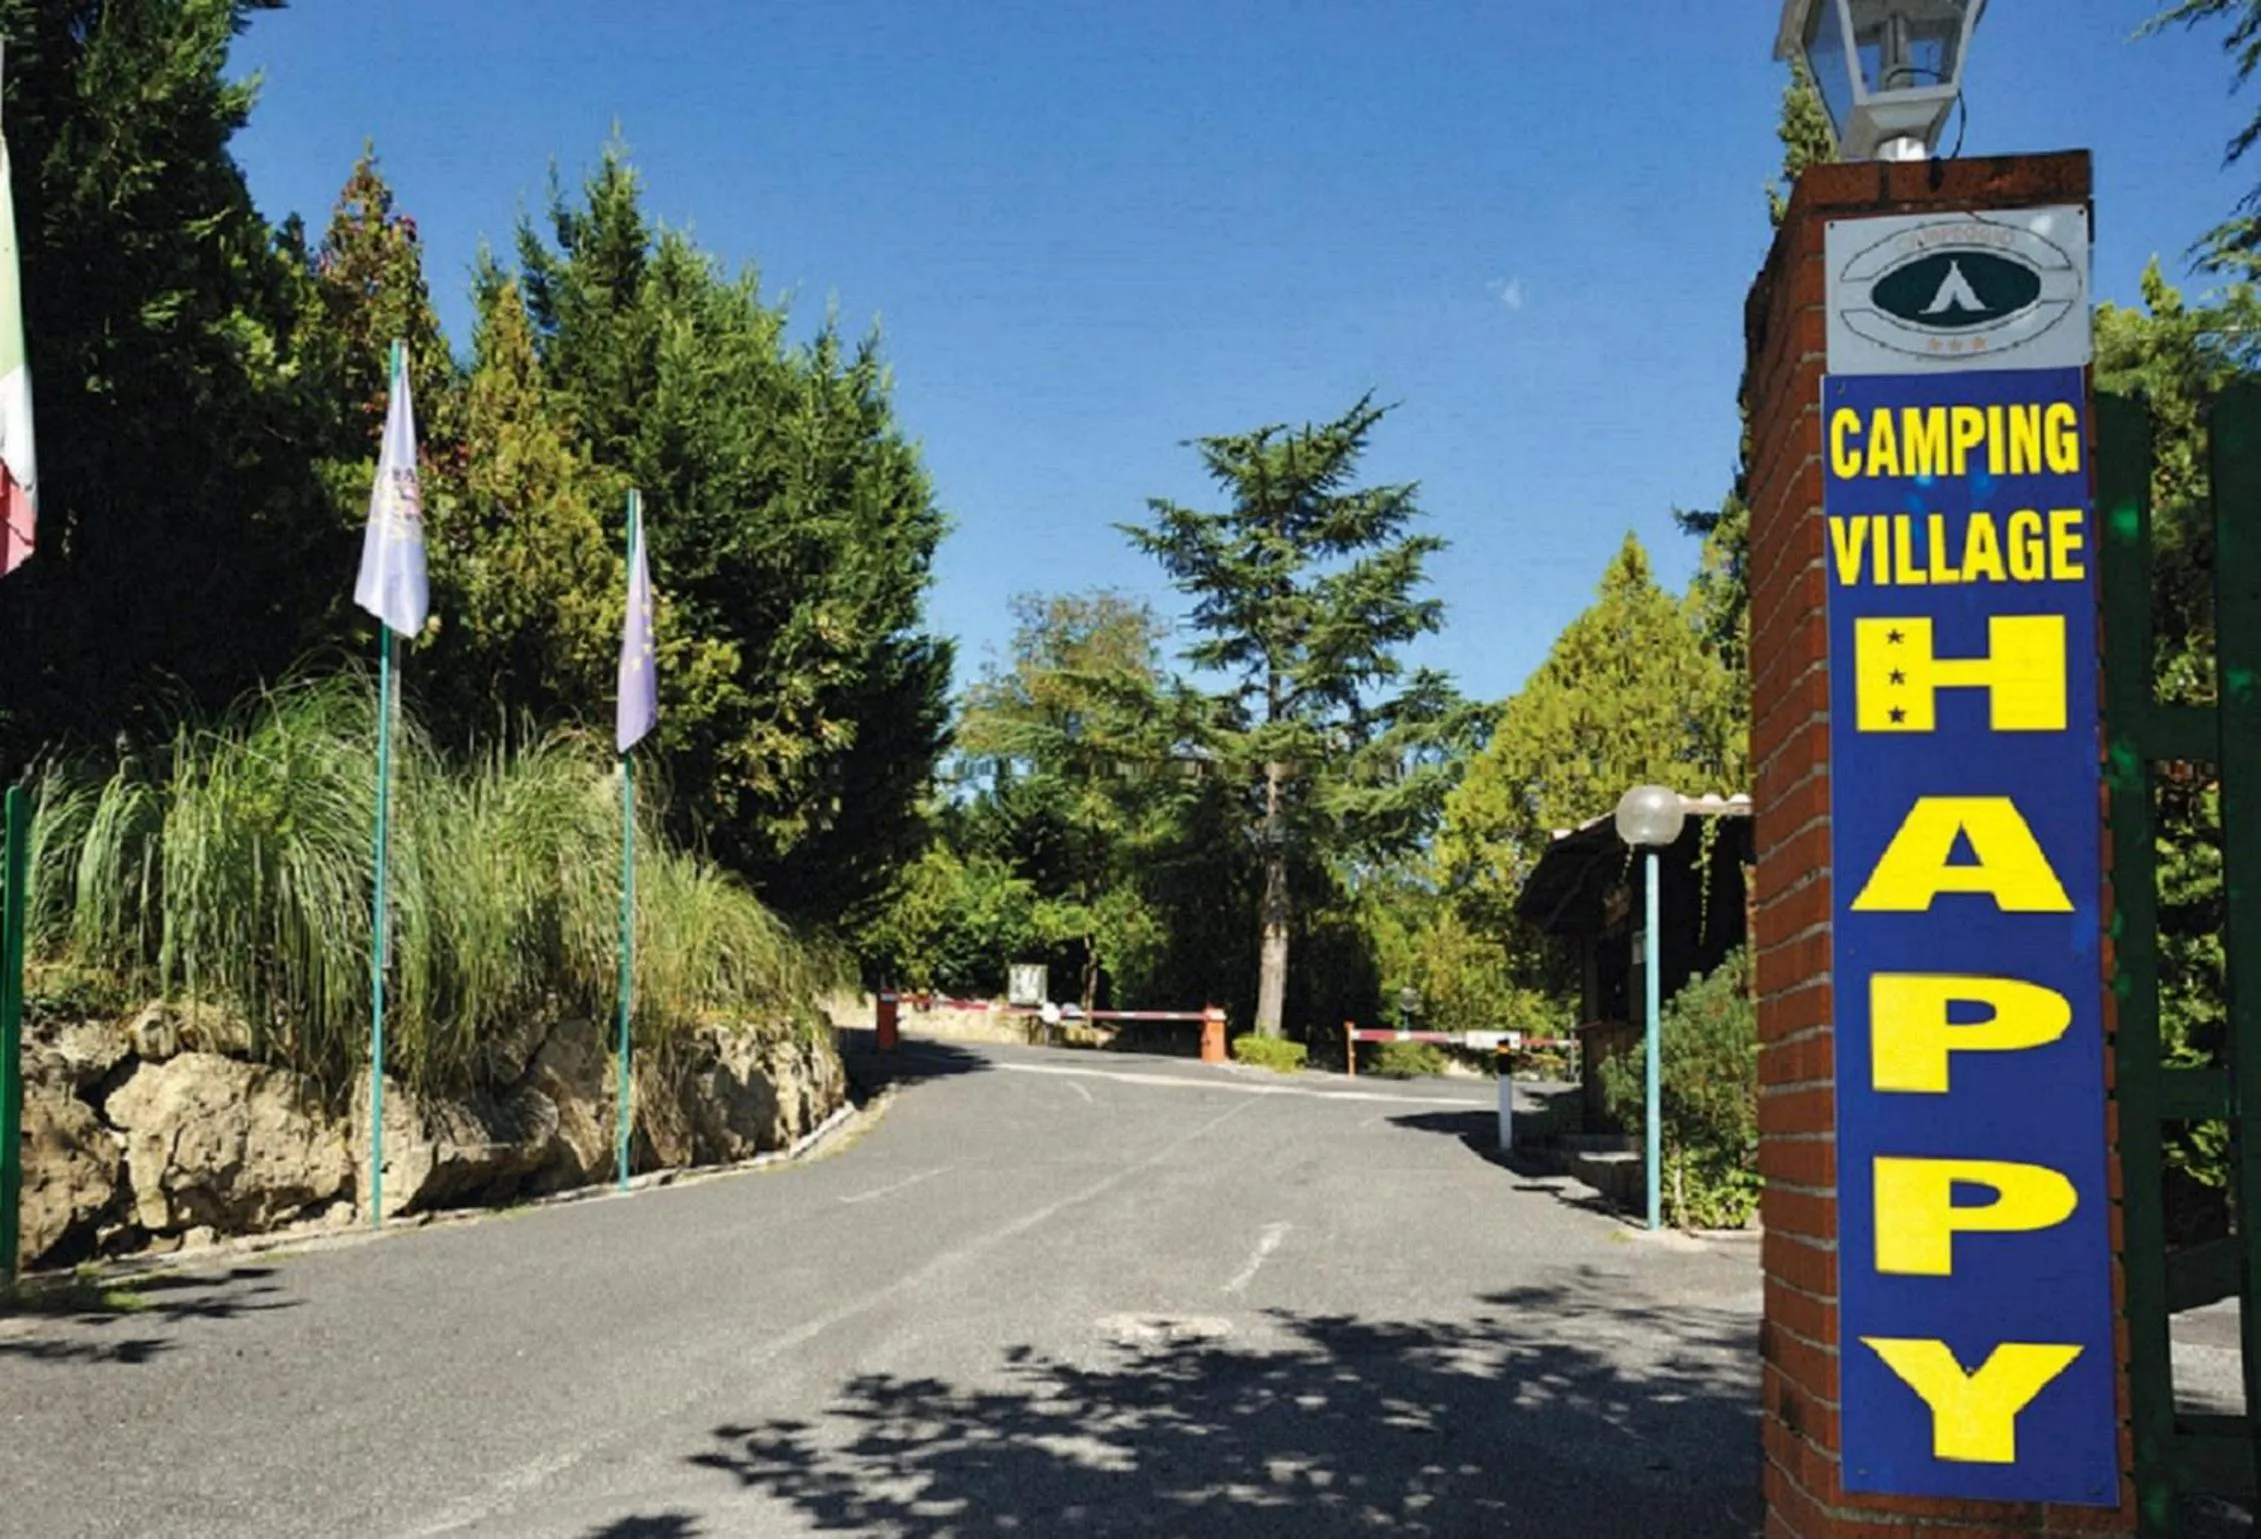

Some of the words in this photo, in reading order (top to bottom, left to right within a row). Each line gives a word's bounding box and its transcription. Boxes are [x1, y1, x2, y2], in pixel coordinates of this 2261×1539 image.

[1829, 402, 2081, 480] CAMPING
[1828, 509, 2086, 586] VILLAGE
[1852, 614, 2082, 1463] HAPPY
